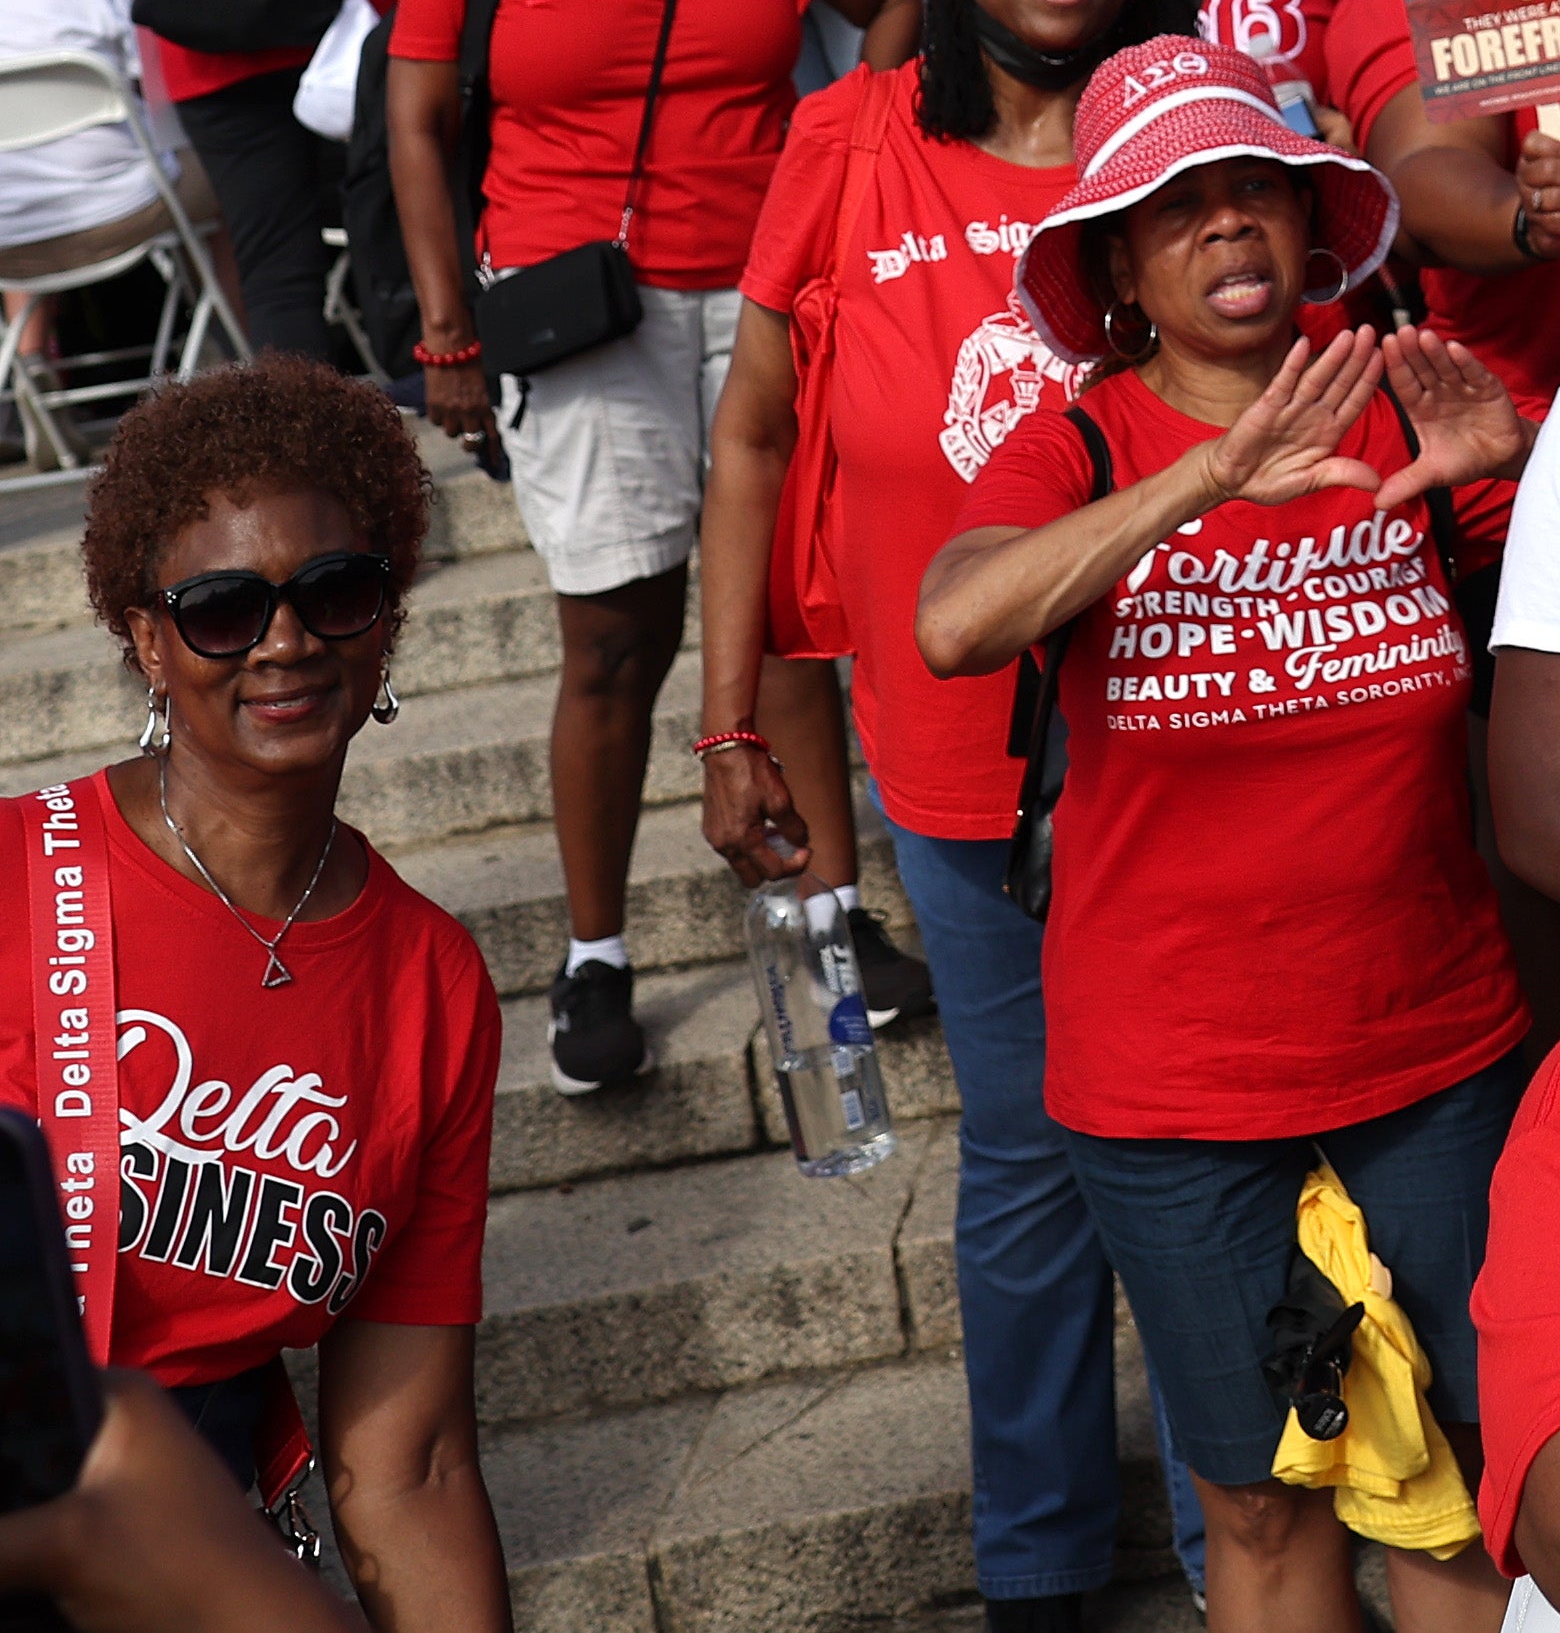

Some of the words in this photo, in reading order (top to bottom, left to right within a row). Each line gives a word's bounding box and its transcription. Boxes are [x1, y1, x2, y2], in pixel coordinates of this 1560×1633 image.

[1463, 13, 1501, 31] THEY
[1503, 2, 1549, 23] WERE
[1122, 51, 1209, 108] ΔΣΘ
[1108, 622, 1237, 660] HOPE
[1255, 584, 1451, 651] WISDOM
[1115, 589, 1281, 619] STRENGTH
[1106, 670, 1237, 702] BEAUTY
[1249, 667, 1278, 694] &
[1284, 622, 1466, 691] Femininity
[1107, 714, 1161, 731] DELTA
[1168, 707, 1248, 729] SIGMA
[1252, 695, 1329, 720] THETA
[1336, 667, 1452, 707] SORORITY,
[49, 865, 96, 996] Sigma
[52, 1006, 93, 1118] Delta
